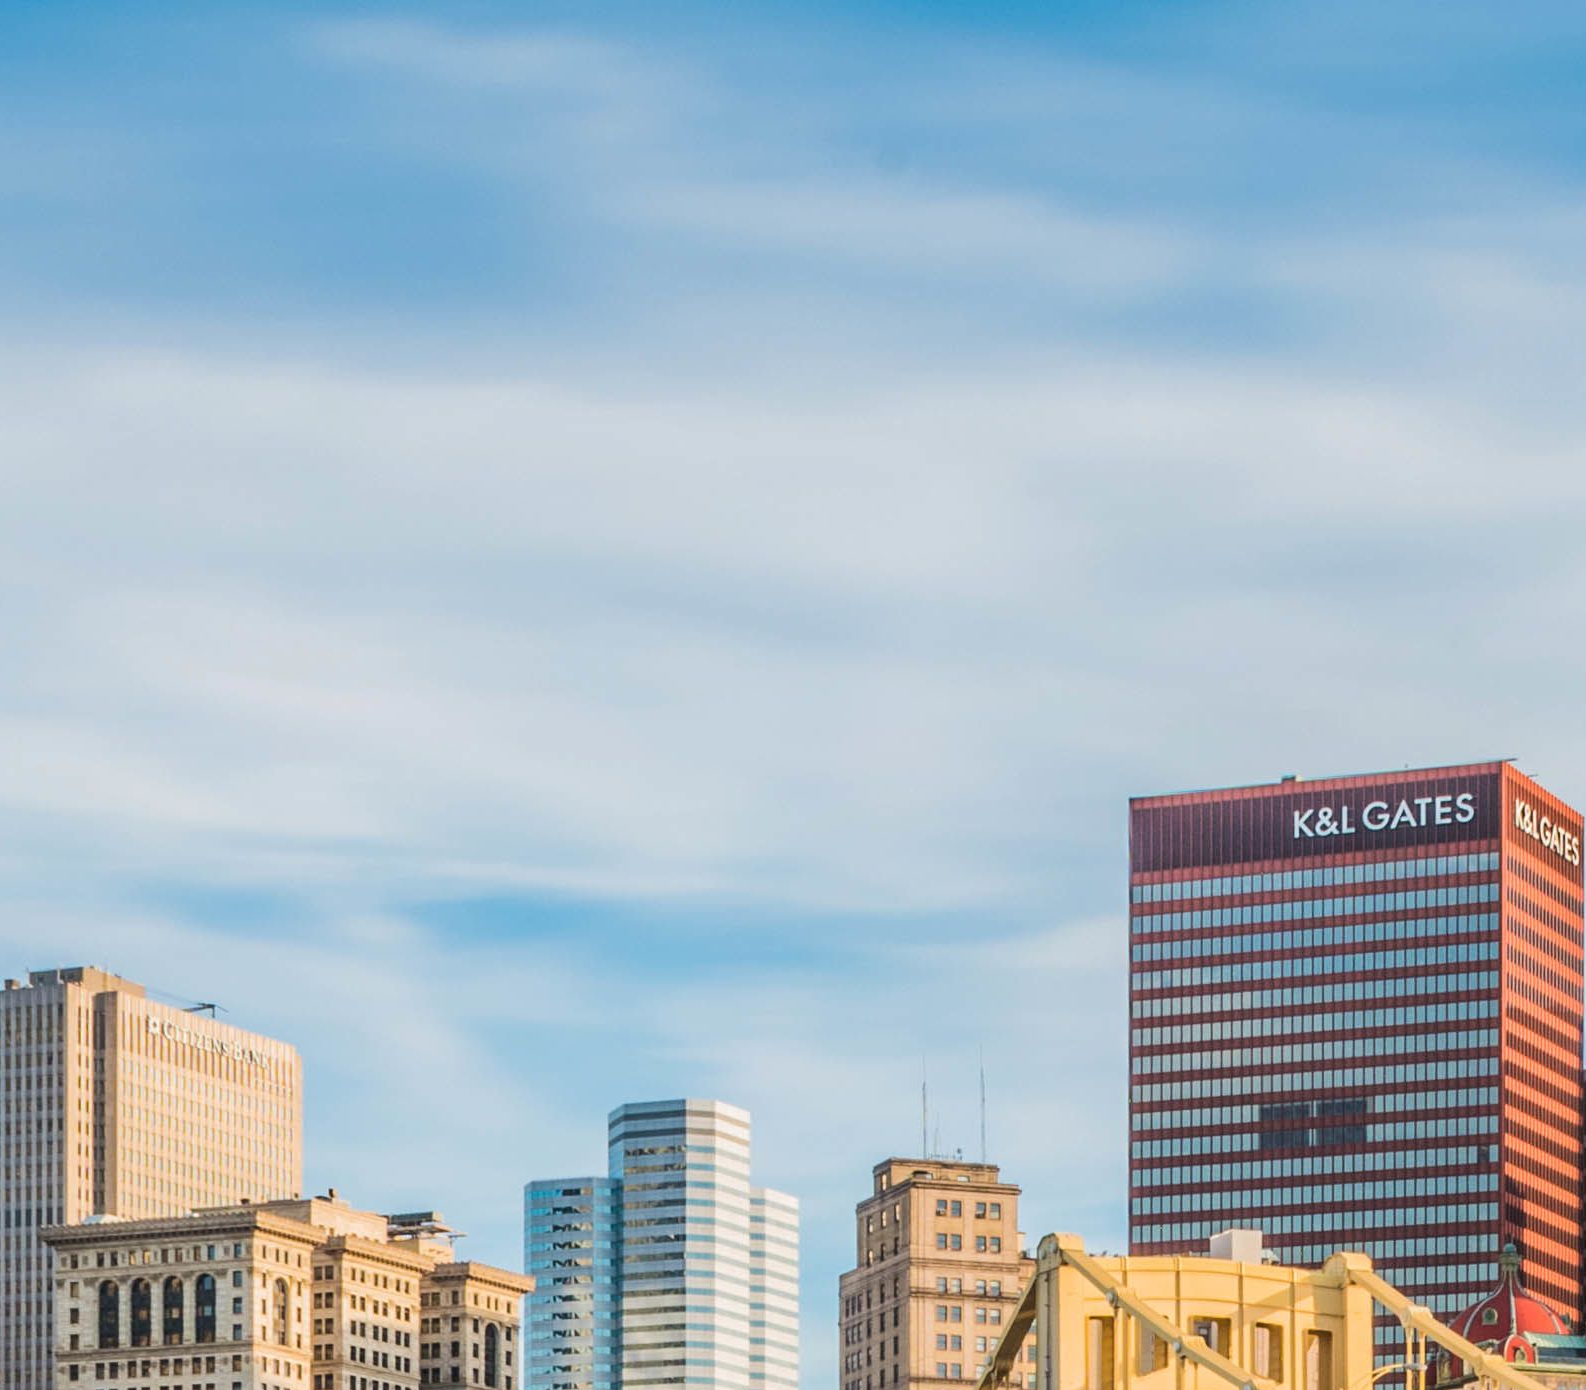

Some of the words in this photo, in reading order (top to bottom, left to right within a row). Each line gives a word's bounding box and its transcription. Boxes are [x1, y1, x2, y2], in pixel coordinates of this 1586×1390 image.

[1292, 806, 1356, 839] K&L
[1362, 793, 1475, 831] GATES
[1515, 798, 1539, 840] K&L
[1539, 815, 1580, 867] GATES
[232, 1040, 270, 1070] BANK
